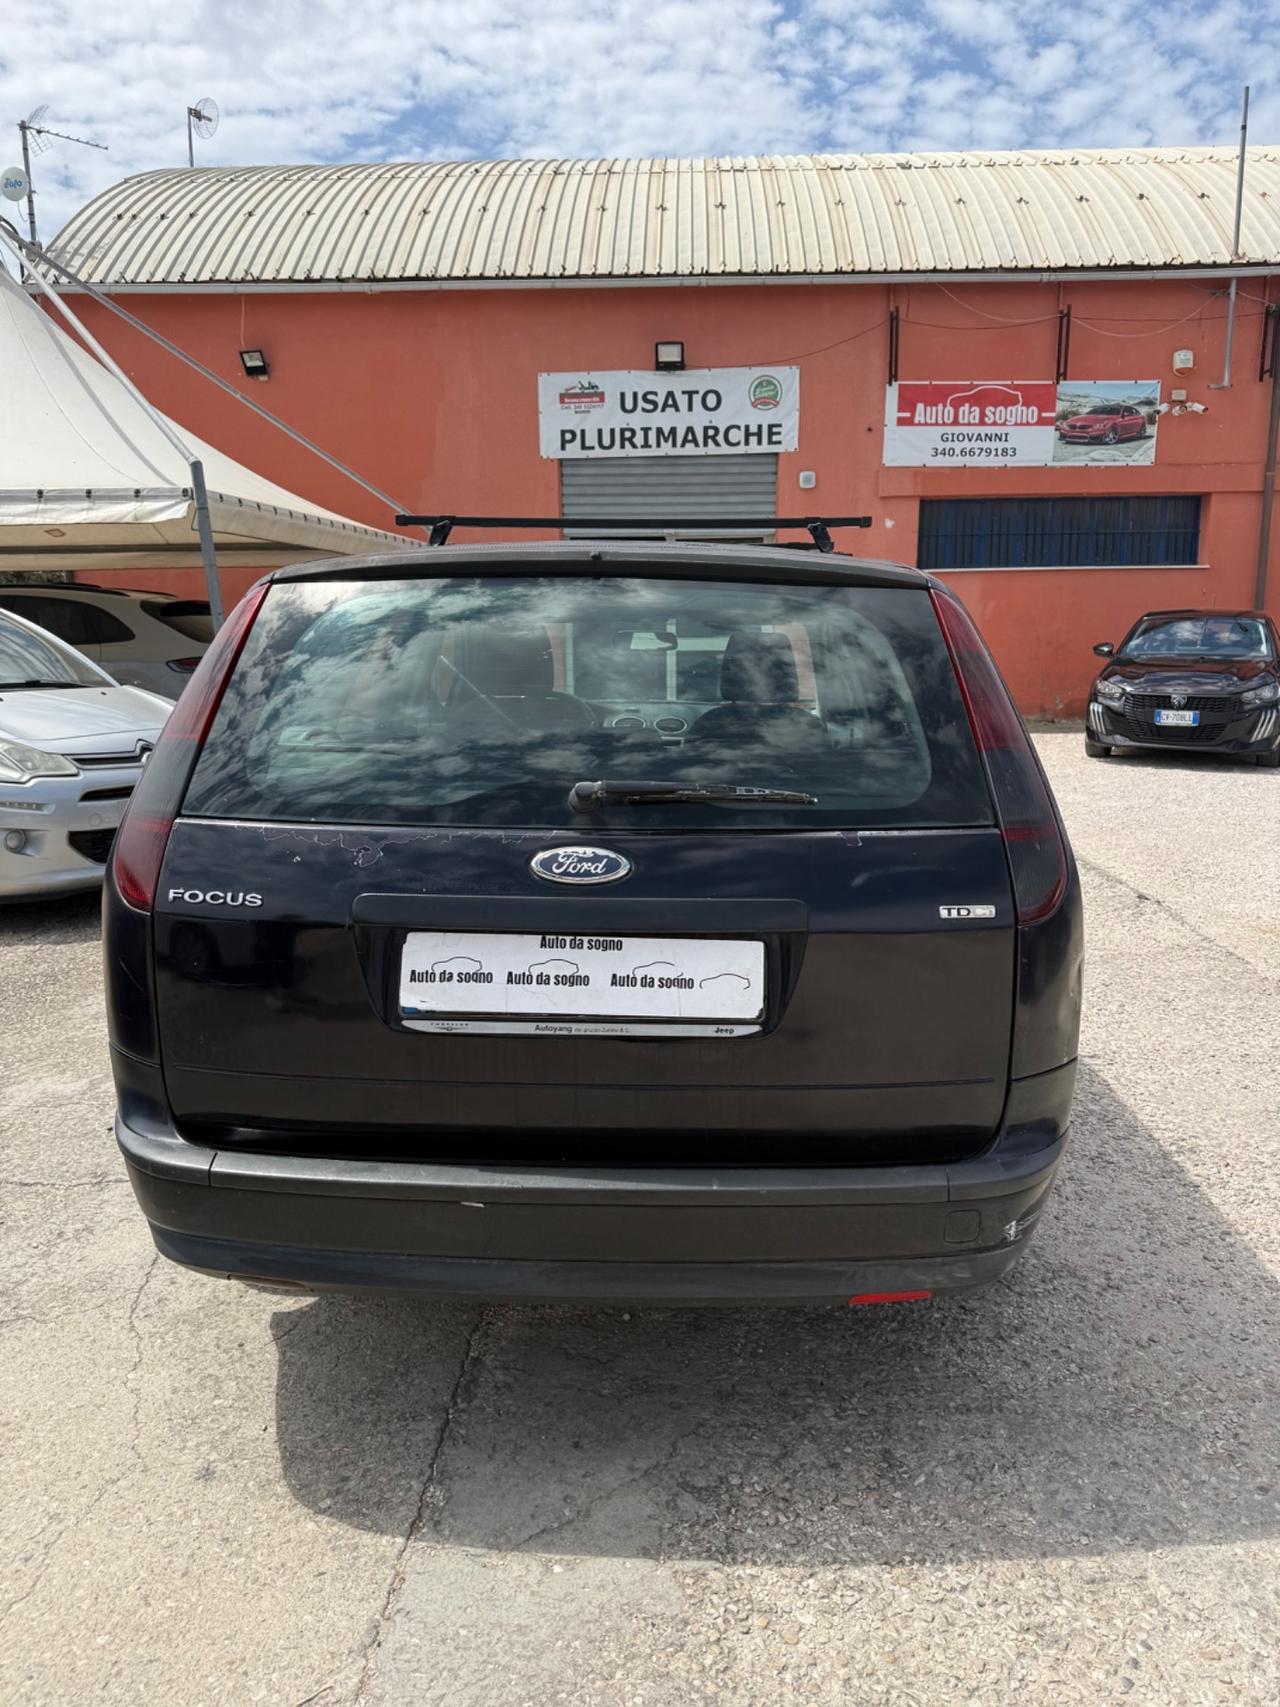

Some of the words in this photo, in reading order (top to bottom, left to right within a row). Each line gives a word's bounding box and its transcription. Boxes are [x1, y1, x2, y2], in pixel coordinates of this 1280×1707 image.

[619, 389, 723, 414] USATO
[914, 402, 955, 424] Auto
[958, 403, 980, 424] da
[984, 405, 1039, 426] sogno
[559, 423, 784, 452] PLURIMARCHE
[940, 432, 1010, 443] GIOVANNI
[930, 446, 1018, 458] 340.6679183
[552, 850, 608, 874] Ford
[168, 888, 263, 907] FOCUS
[540, 935, 567, 950] Auto
[569, 936, 584, 950] da
[587, 938, 623, 952] sogno
[409, 969, 436, 983] Auto
[438, 969, 454, 983] da
[506, 971, 534, 985] Auto
[536, 972, 551, 986] da
[553, 973, 590, 988] sogno
[610, 973, 638, 987] Auto
[640, 974, 655, 988] da
[534, 1024, 573, 1034] Autoyang
[714, 1026, 735, 1035] Jeep
